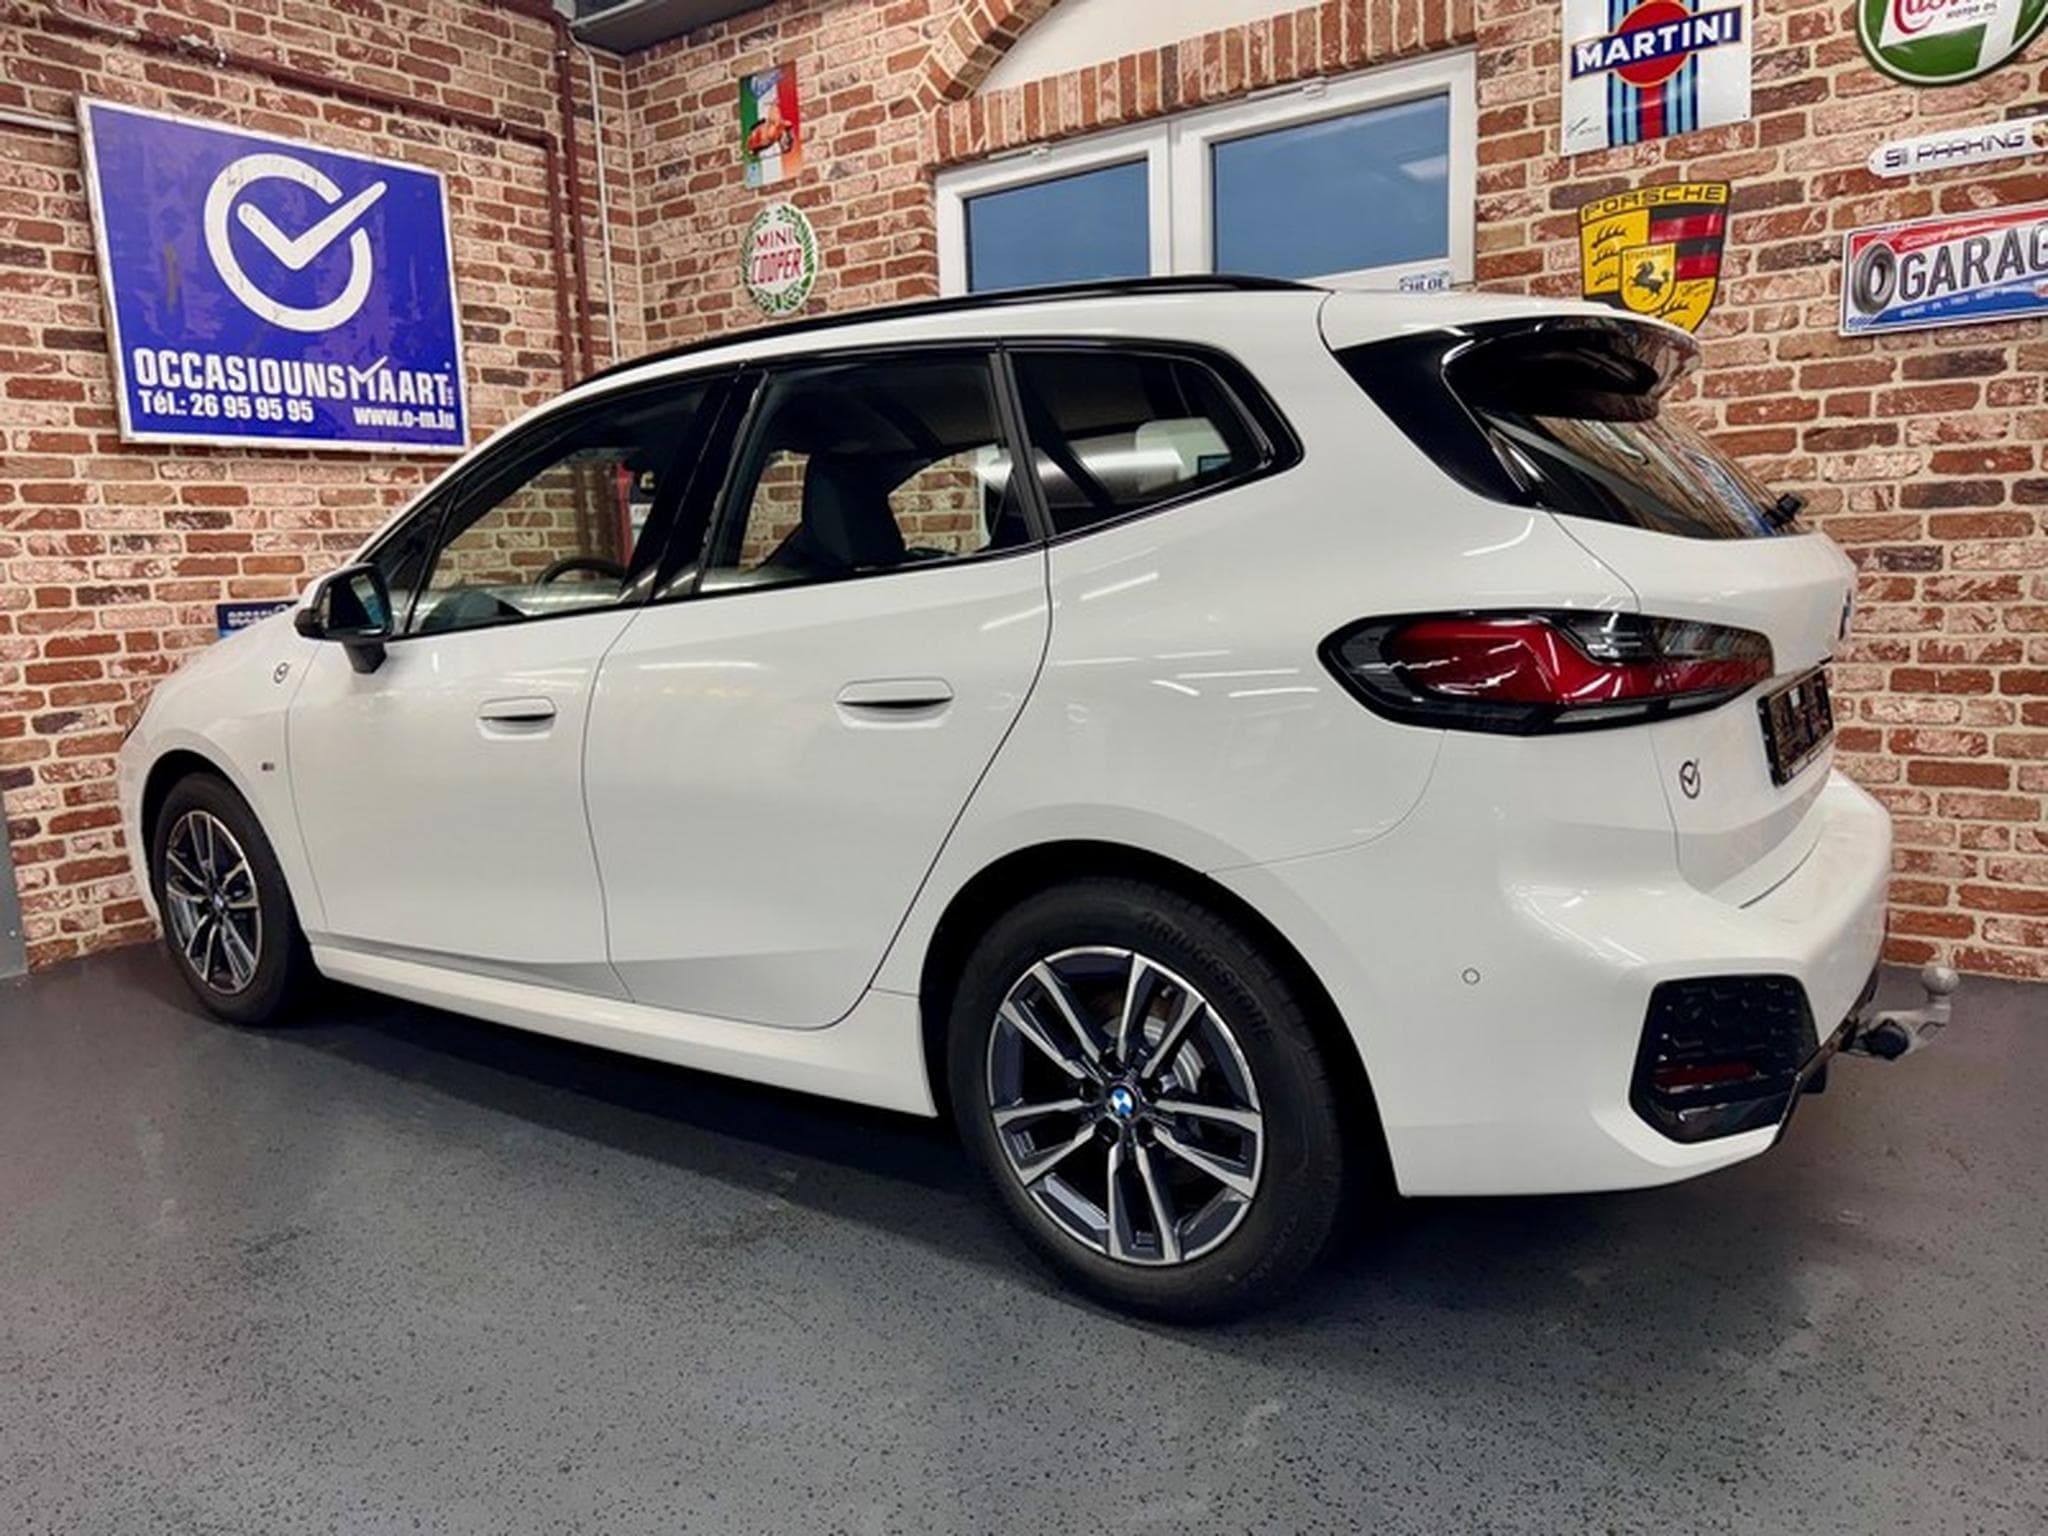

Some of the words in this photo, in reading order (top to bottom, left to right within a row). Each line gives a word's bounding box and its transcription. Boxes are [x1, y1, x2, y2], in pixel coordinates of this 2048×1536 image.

[1576, 12, 1733, 73] MARTINI
[1917, 128, 2025, 163] PARKING
[1584, 186, 1724, 221] PORSCHE
[756, 226, 793, 248] MINI
[751, 247, 802, 285] COOPER
[189, 393, 219, 418] 26
[222, 394, 252, 420] 95
[255, 396, 284, 422] 95
[286, 398, 314, 423] 95
